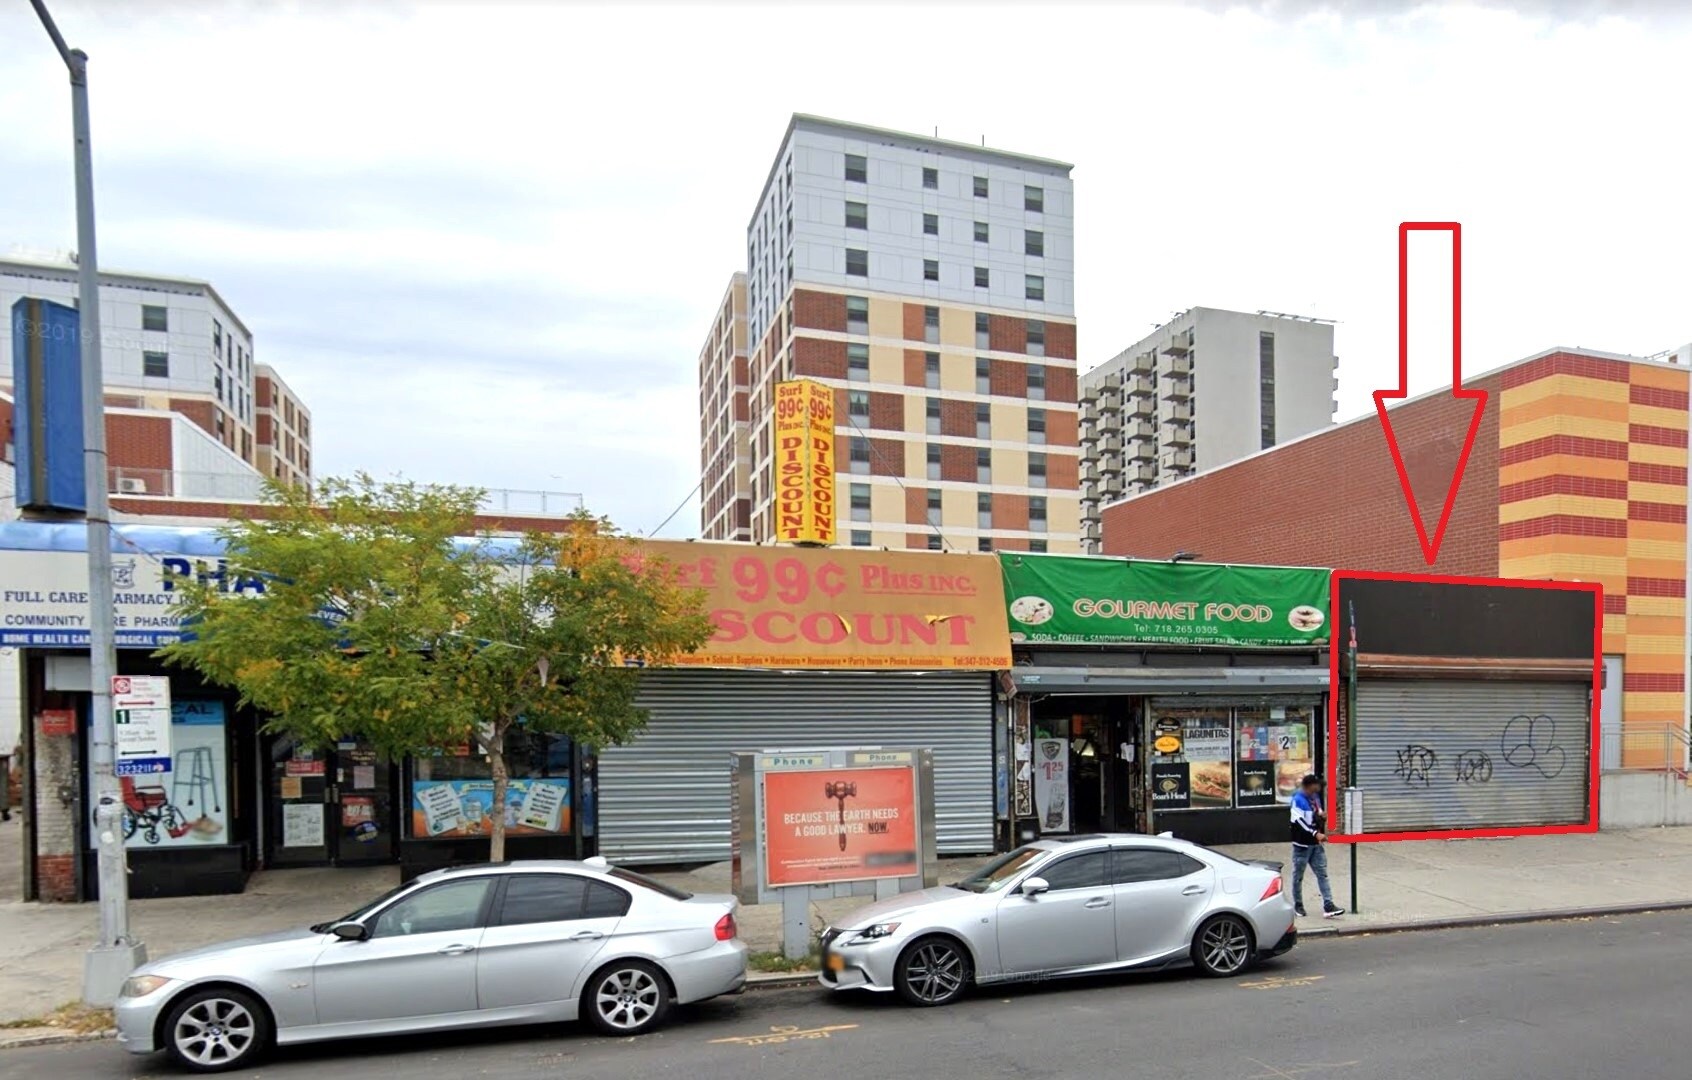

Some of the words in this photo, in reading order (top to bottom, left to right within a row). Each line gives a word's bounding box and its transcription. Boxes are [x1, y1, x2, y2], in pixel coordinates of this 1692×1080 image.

[779, 384, 803, 398] Surf
[810, 385, 831, 401] Surf
[778, 398, 804, 420] 99¢
[809, 397, 832, 421] 99¢
[781, 436, 804, 539] DISCOUNT
[813, 437, 832, 541] DISCOUNT
[163, 557, 265, 594] PHA
[731, 555, 847, 605] 99¢
[861, 564, 923, 591] Plus
[928, 575, 977, 592] INC.
[4, 590, 44, 603] FULL
[48, 591, 89, 603] CARE
[113, 593, 173, 605] ARMACY
[1073, 598, 1199, 621] GOURMET
[1204, 602, 1273, 622] FOOD
[5, 614, 85, 626] COMMUNITY
[134, 616, 179, 627] PHARM
[711, 608, 976, 647] SCOUNT
[1154, 624, 1218, 634] 718.265.0305
[71, 634, 91, 644] CAR
[114, 635, 155, 645] URGICAL
[1031, 633, 1052, 642] SODA
[1058, 634, 1084, 643] COFFEE
[1169, 636, 1189, 644] FOOD
[712, 655, 733, 665] School
[737, 656, 763, 666] Supplies
[1185, 729, 1230, 739] LAGUNITAS
[773, 757, 813, 766] Phone
[869, 753, 897, 761] Phone
[784, 812, 823, 824] BECAUSE
[825, 811, 841, 822] THE
[843, 809, 870, 821] EARTH
[872, 808, 899, 820] NEEDS
[795, 827, 802, 837] A
[803, 825, 827, 836] GOOD
[828, 823, 865, 835] LAWYER.
[868, 822, 889, 834] NOW.
